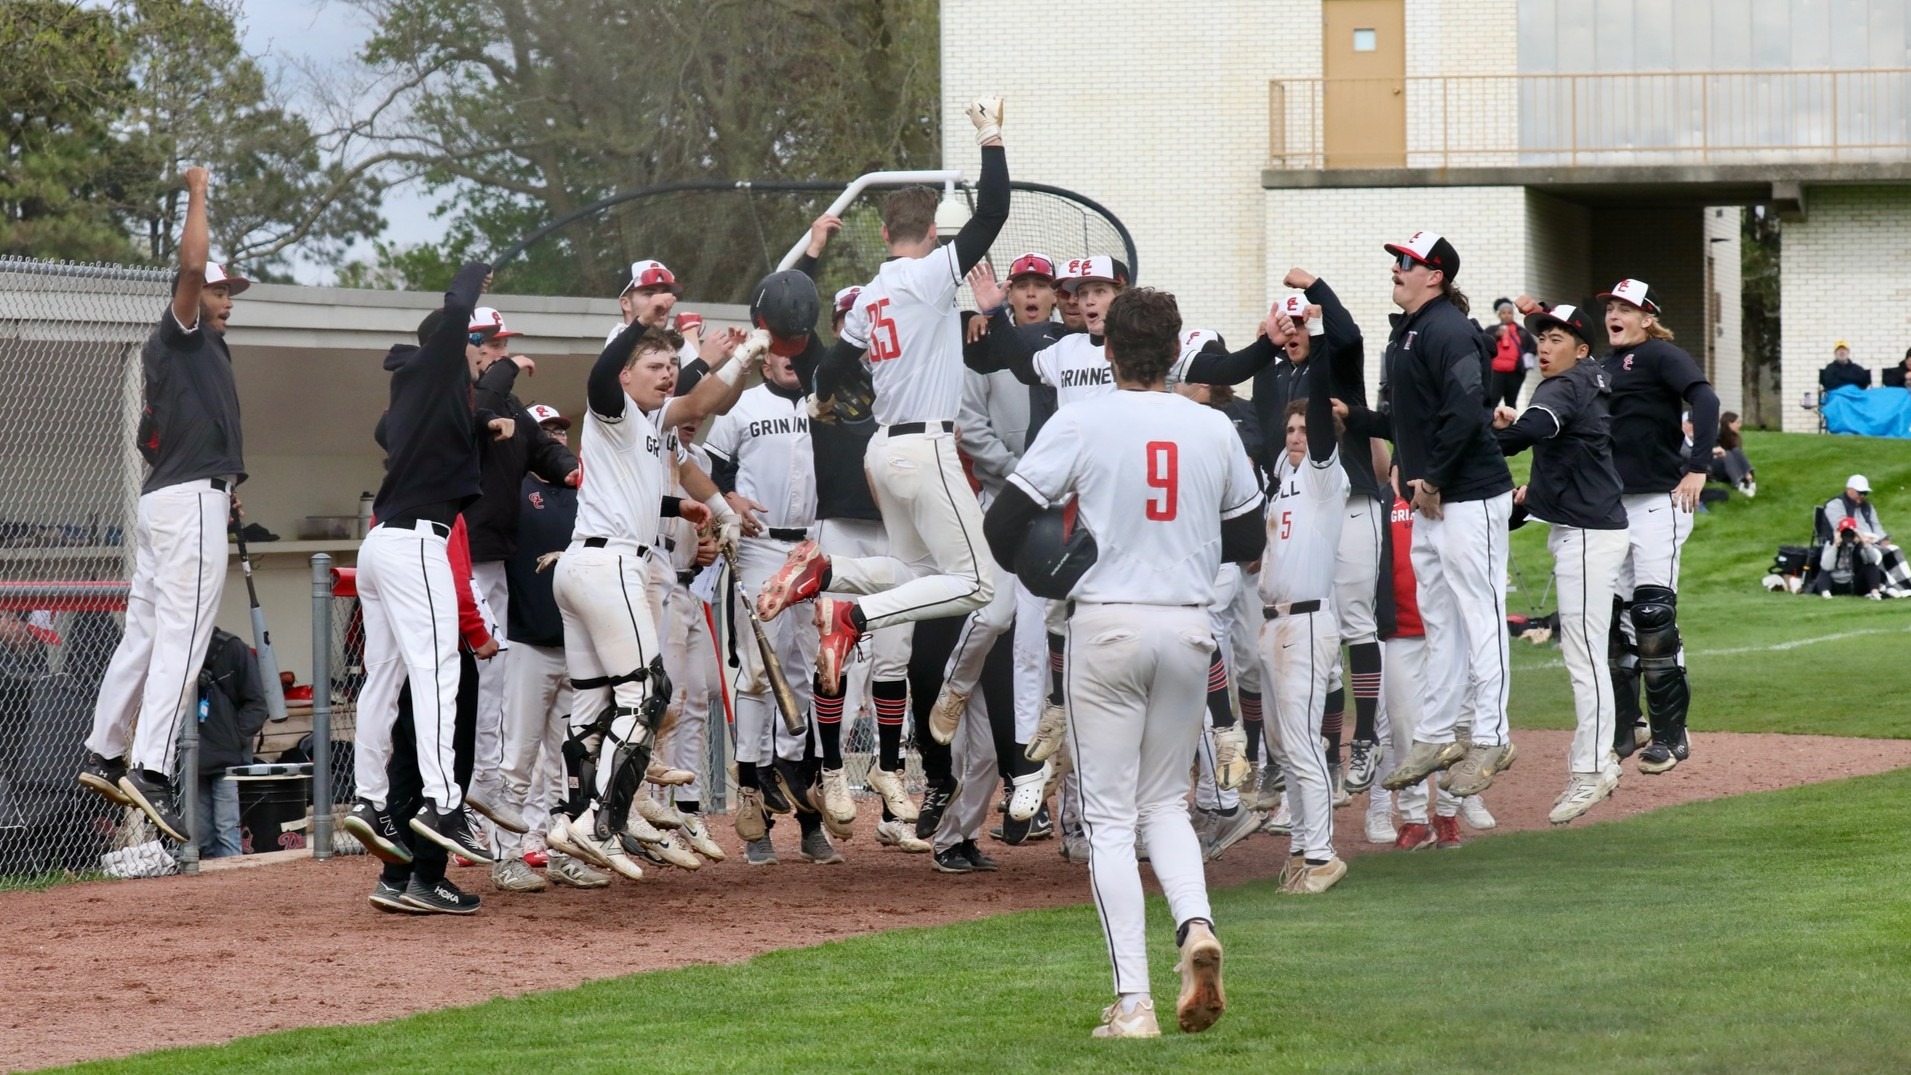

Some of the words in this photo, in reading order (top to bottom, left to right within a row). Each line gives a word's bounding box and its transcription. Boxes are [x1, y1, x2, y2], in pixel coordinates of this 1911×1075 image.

[866, 298, 901, 362] 35
[1146, 441, 1178, 522] 9
[1281, 511, 1292, 540] 5
[433, 885, 459, 904] HOKA
